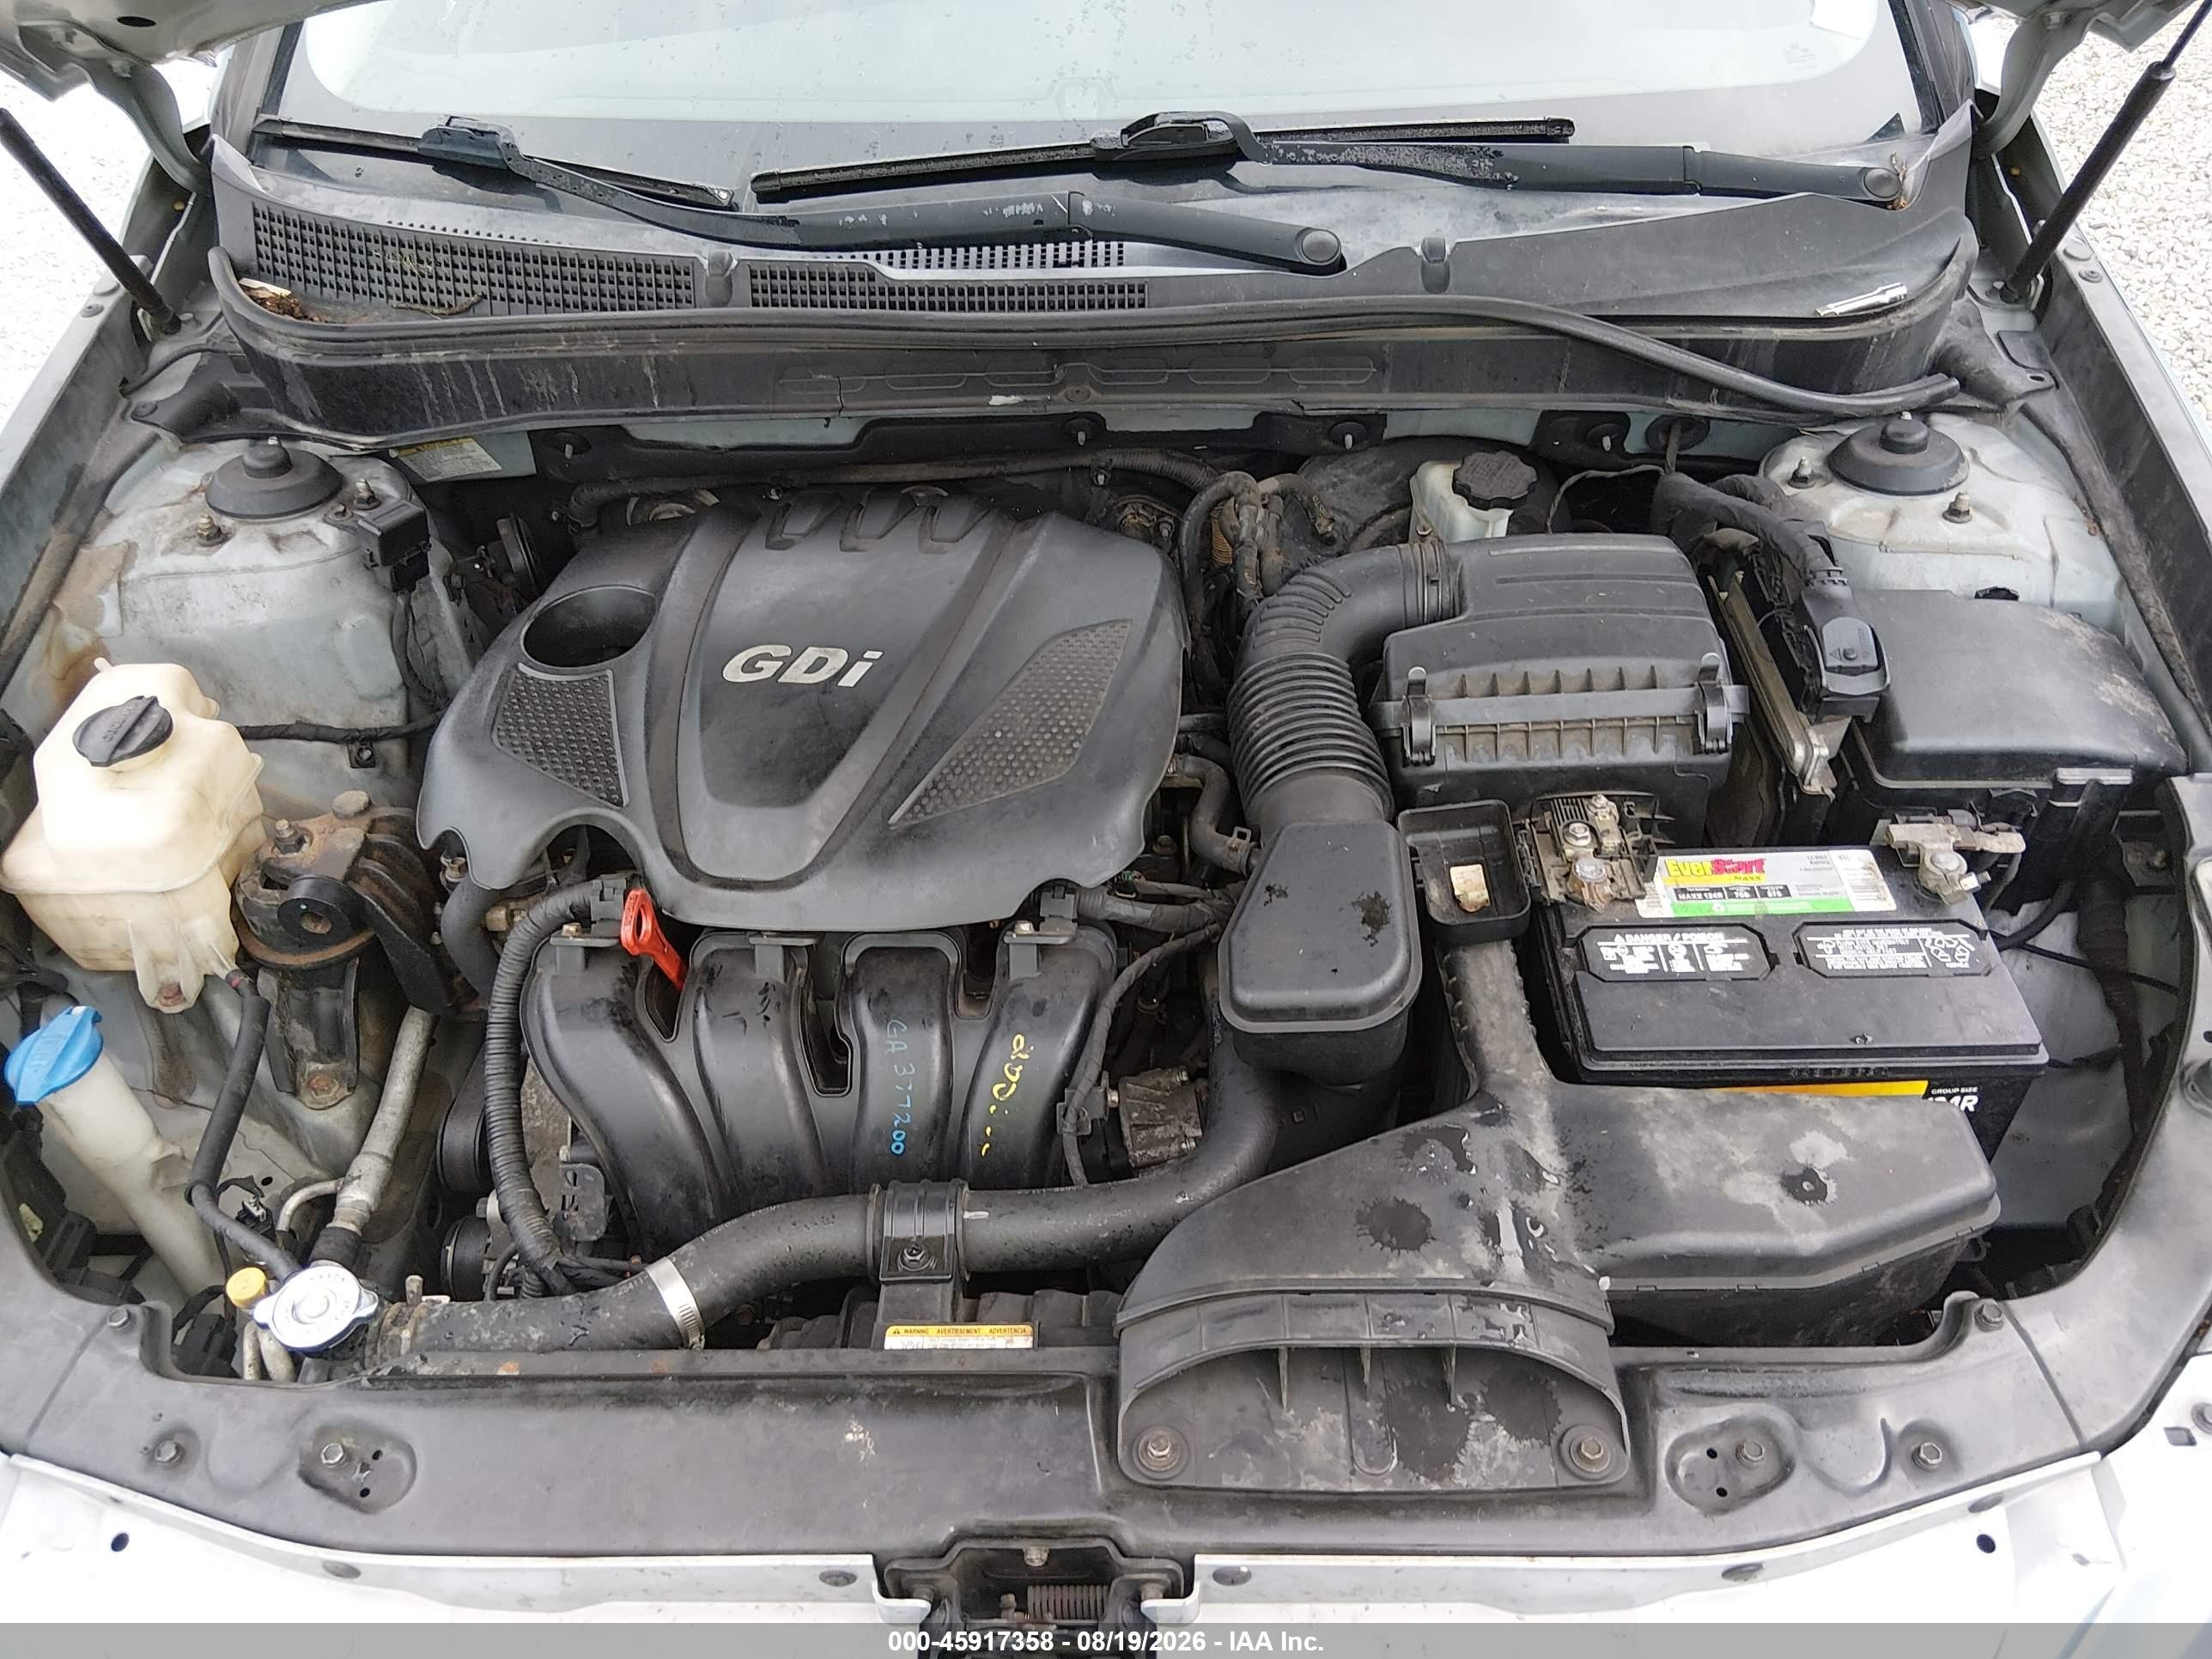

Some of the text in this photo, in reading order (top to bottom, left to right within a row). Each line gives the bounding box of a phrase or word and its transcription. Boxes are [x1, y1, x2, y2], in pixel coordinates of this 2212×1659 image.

[722, 644, 884, 688] GDi
[1665, 858, 1766, 877] EverStart
[1625, 933, 1673, 943] DANGER
[1681, 933, 1725, 943] POISON
